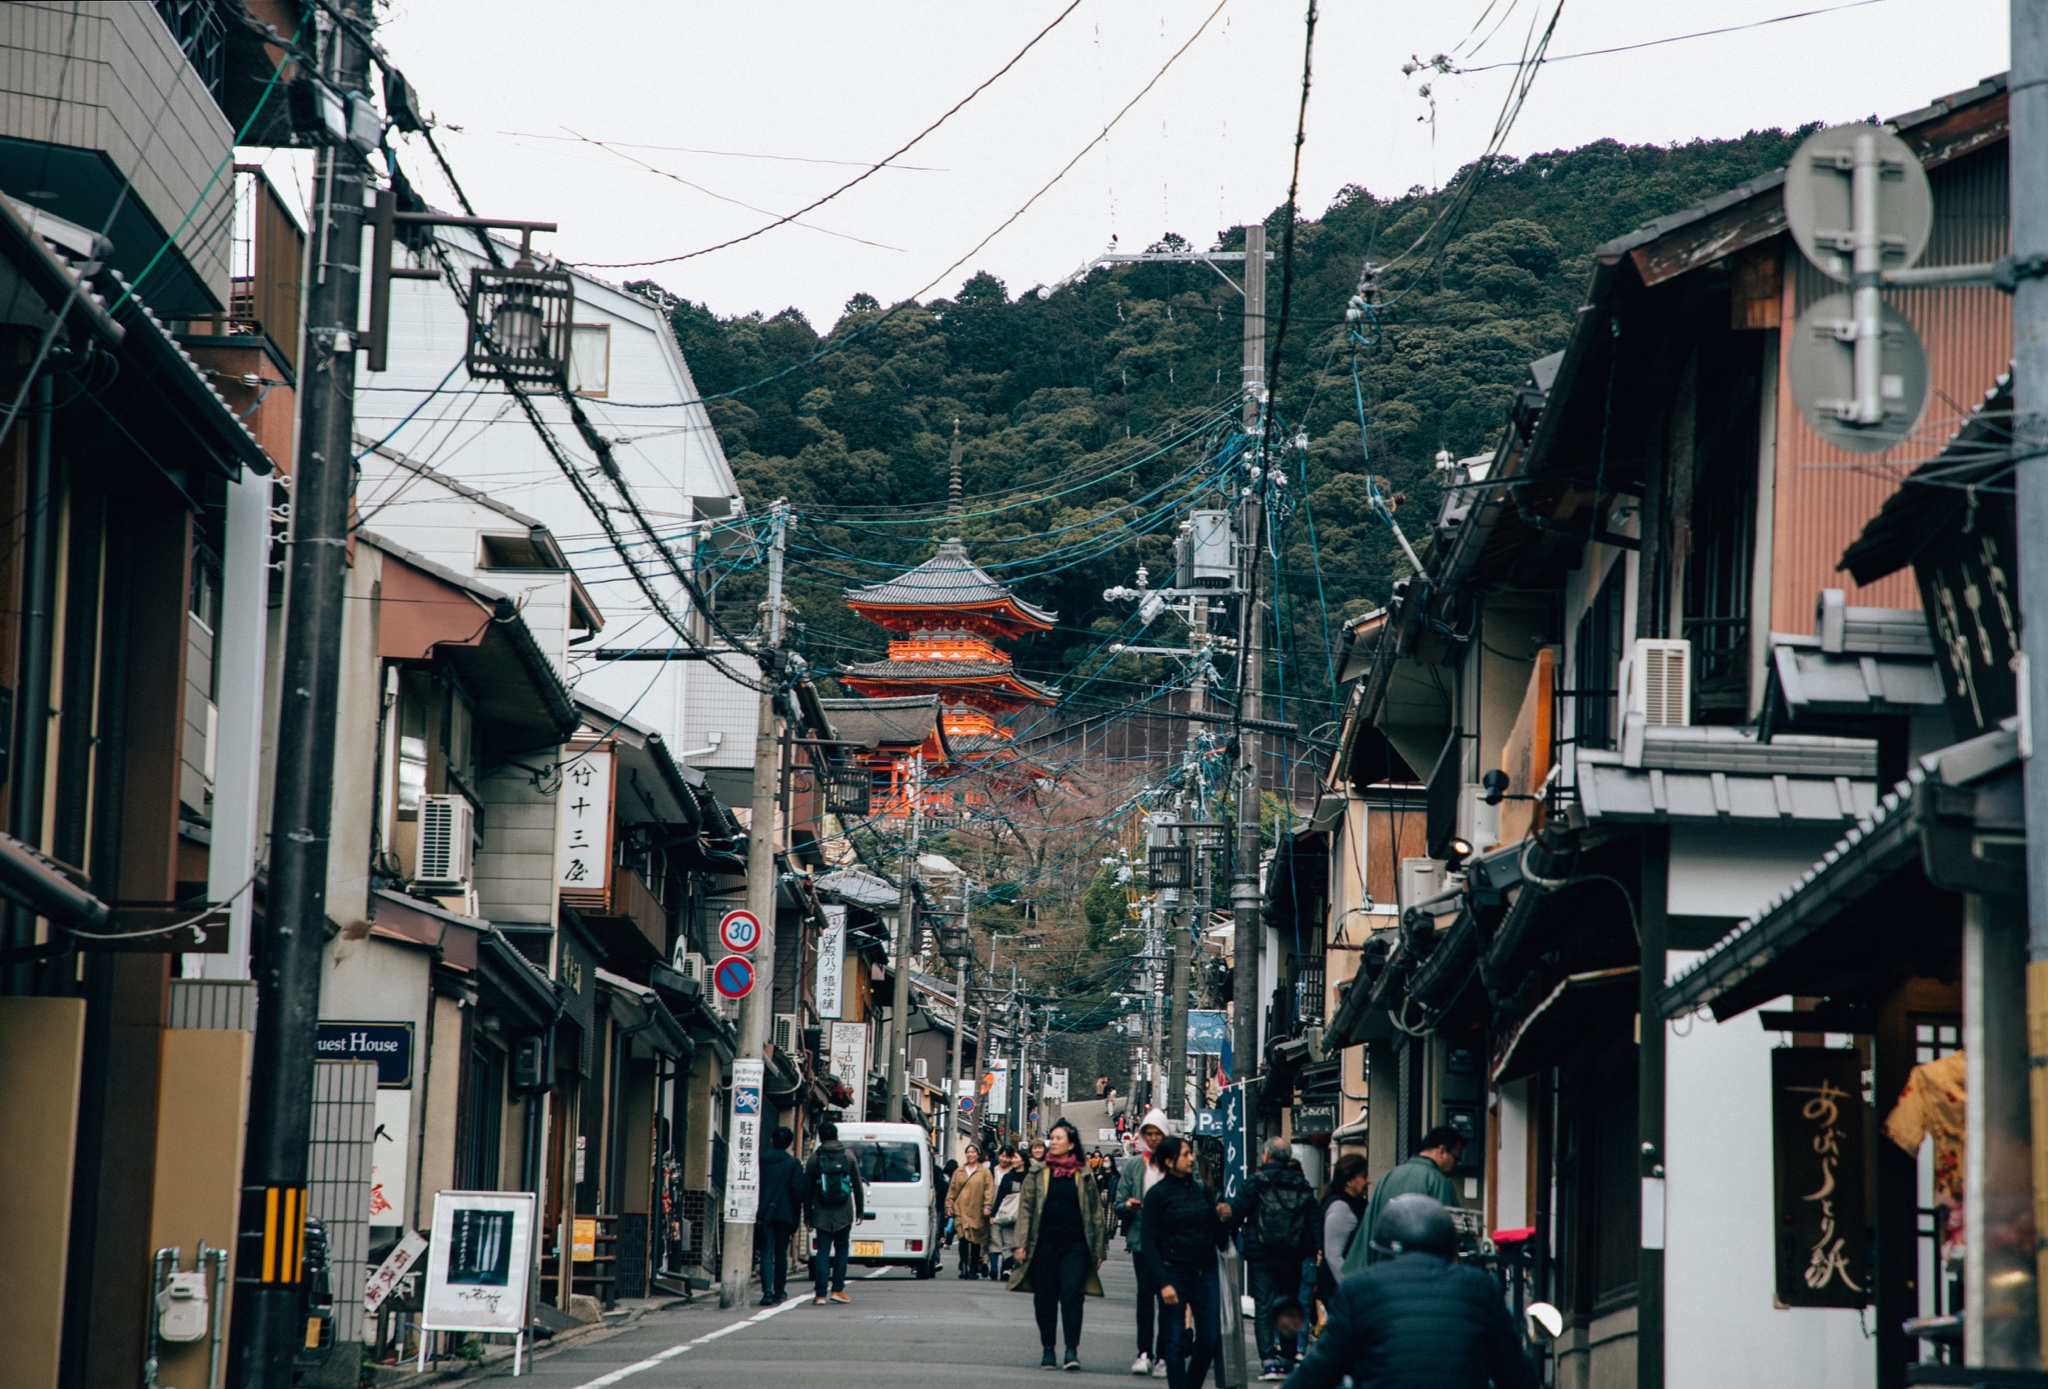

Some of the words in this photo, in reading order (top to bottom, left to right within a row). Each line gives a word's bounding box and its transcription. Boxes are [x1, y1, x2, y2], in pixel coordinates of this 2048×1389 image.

[564, 765, 593, 882] 竹十三屋
[728, 921, 753, 942] 30
[315, 1037, 347, 1051] uest
[349, 1032, 399, 1052] House
[737, 1120, 754, 1181] 駐輪禁止
